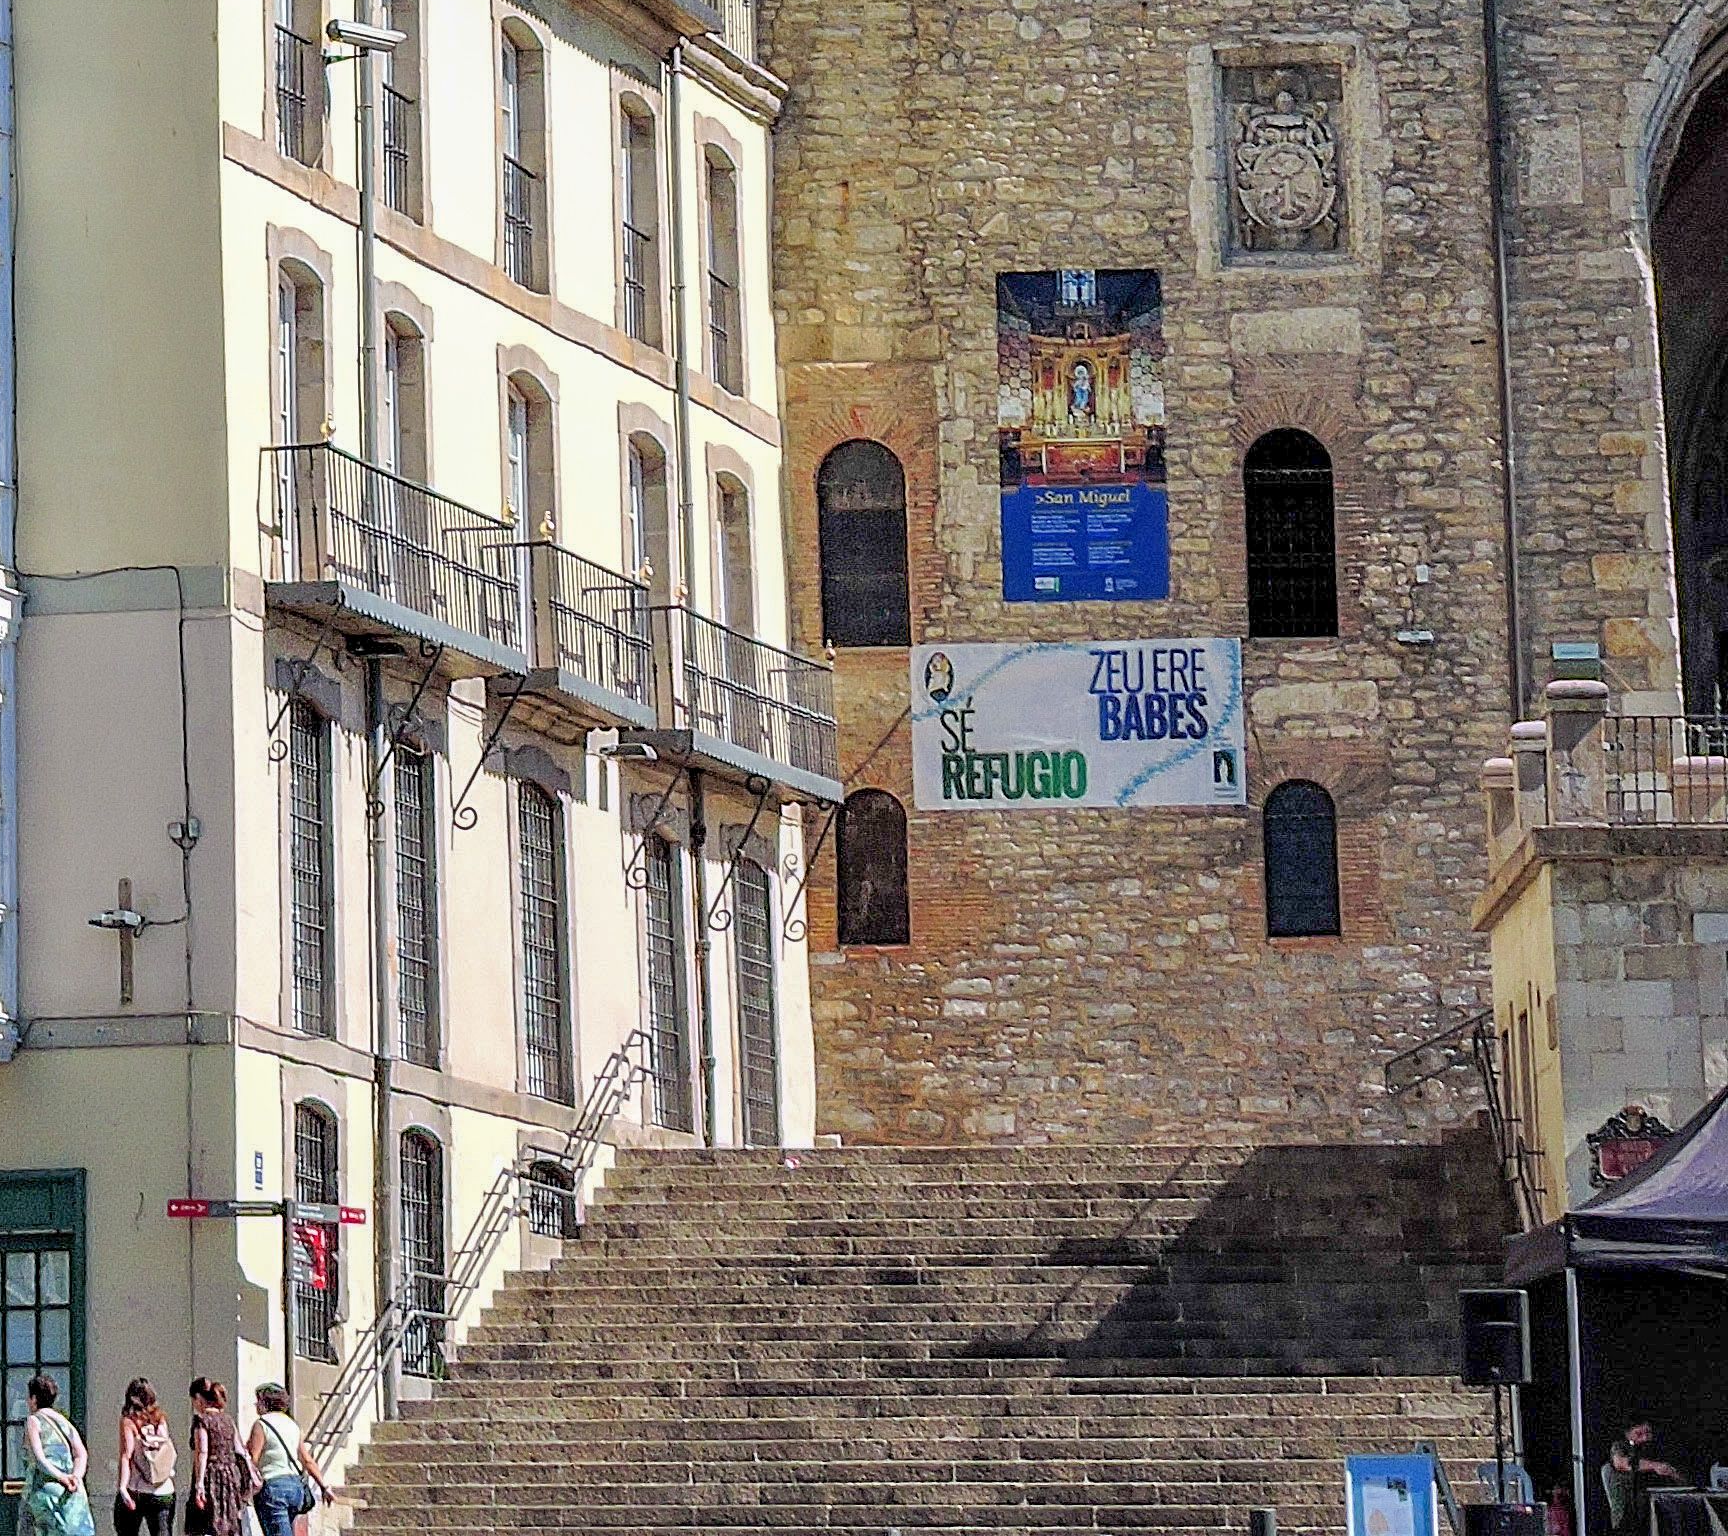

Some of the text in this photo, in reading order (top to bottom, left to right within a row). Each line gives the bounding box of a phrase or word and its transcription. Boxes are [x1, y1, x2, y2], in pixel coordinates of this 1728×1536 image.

[1079, 488, 1130, 507] Miguel
[1088, 648, 1207, 694] ZEU ERE
[940, 697, 976, 753] SÉ
[1099, 693, 1209, 741] BABES
[942, 751, 1088, 800] REFUGIO
